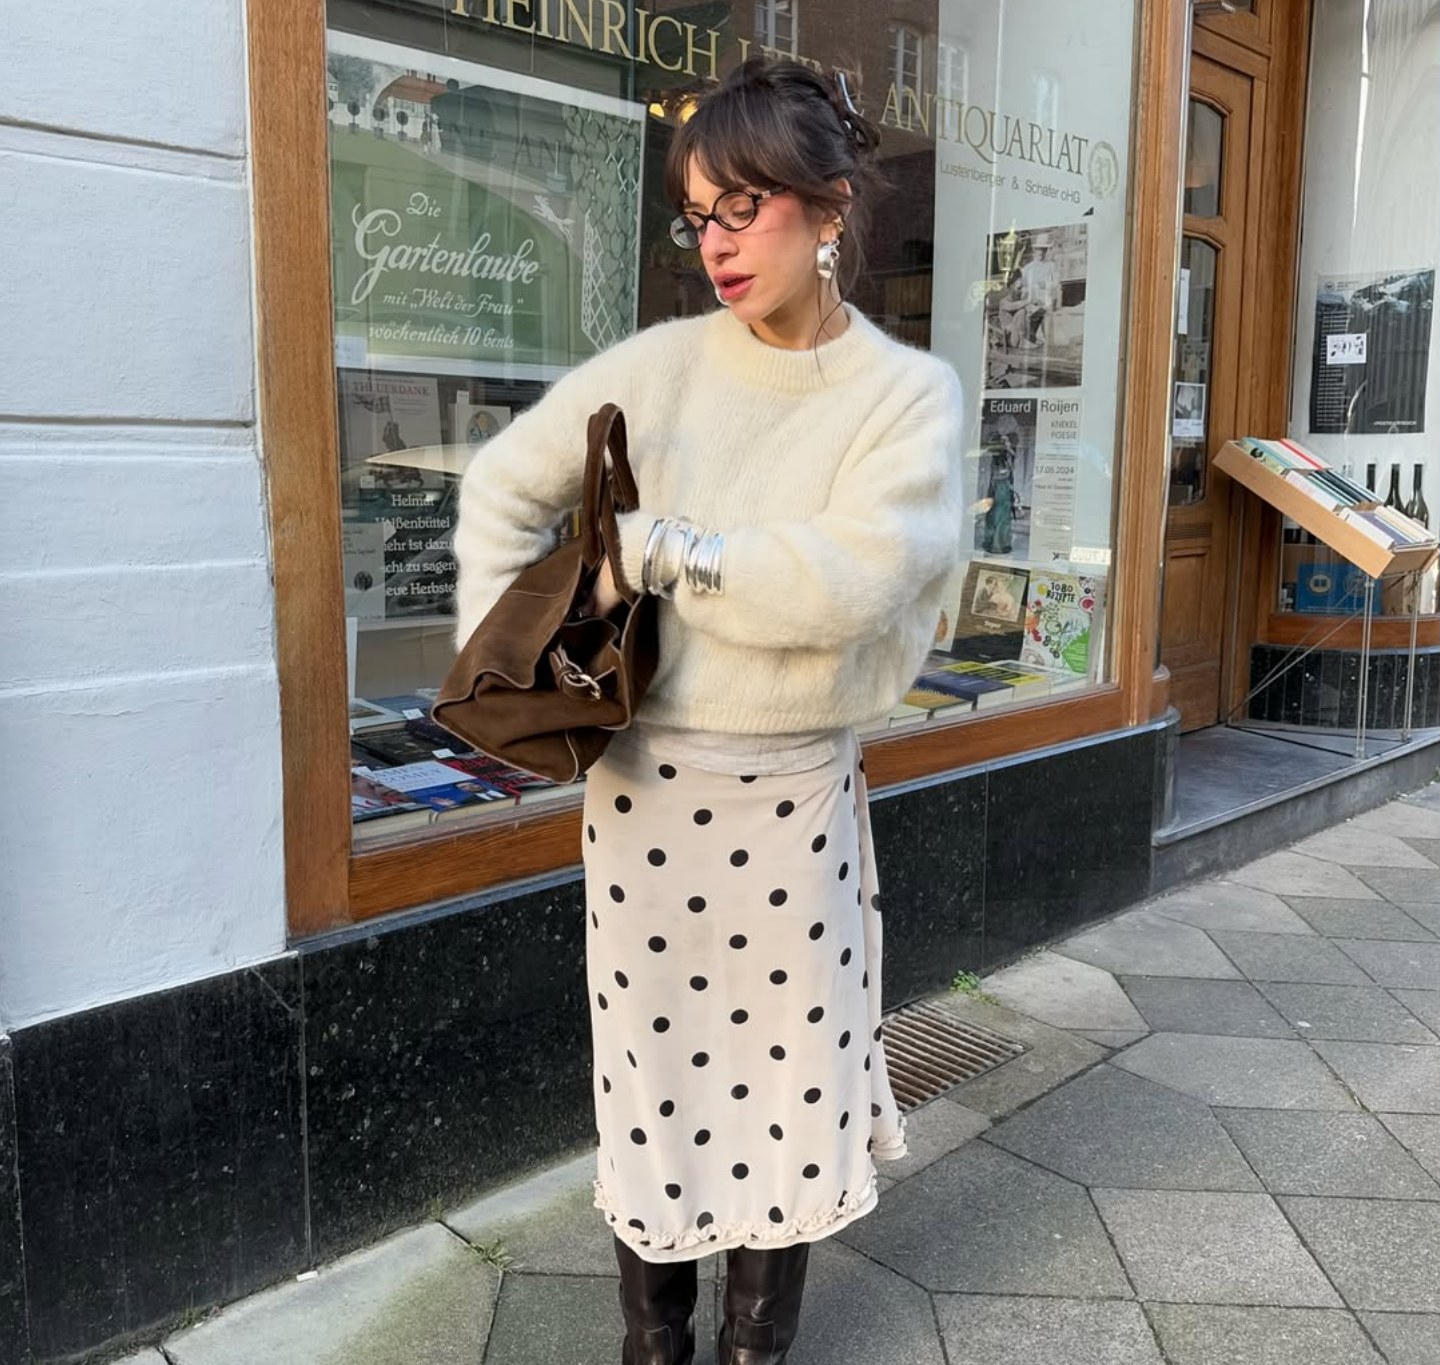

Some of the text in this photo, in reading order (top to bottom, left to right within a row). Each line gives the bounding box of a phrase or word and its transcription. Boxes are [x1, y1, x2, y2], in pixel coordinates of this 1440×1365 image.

[879, 82, 1088, 175] ANTIQUARIAT
[939, 160, 1006, 187] Lustenberger
[1011, 176, 1019, 191] &
[406, 191, 442, 218] Die
[352, 203, 540, 304] Gartenlaube
[384, 291, 408, 306] mit
[454, 294, 476, 312] der
[369, 320, 459, 346] wöchentlich
[462, 327, 482, 346] 10
[990, 400, 1079, 415] Eduard Roijen
[409, 539, 423, 551] ist
[425, 538, 453, 550] dazu
[406, 562, 420, 573] zu
[422, 560, 457, 575] sagen
